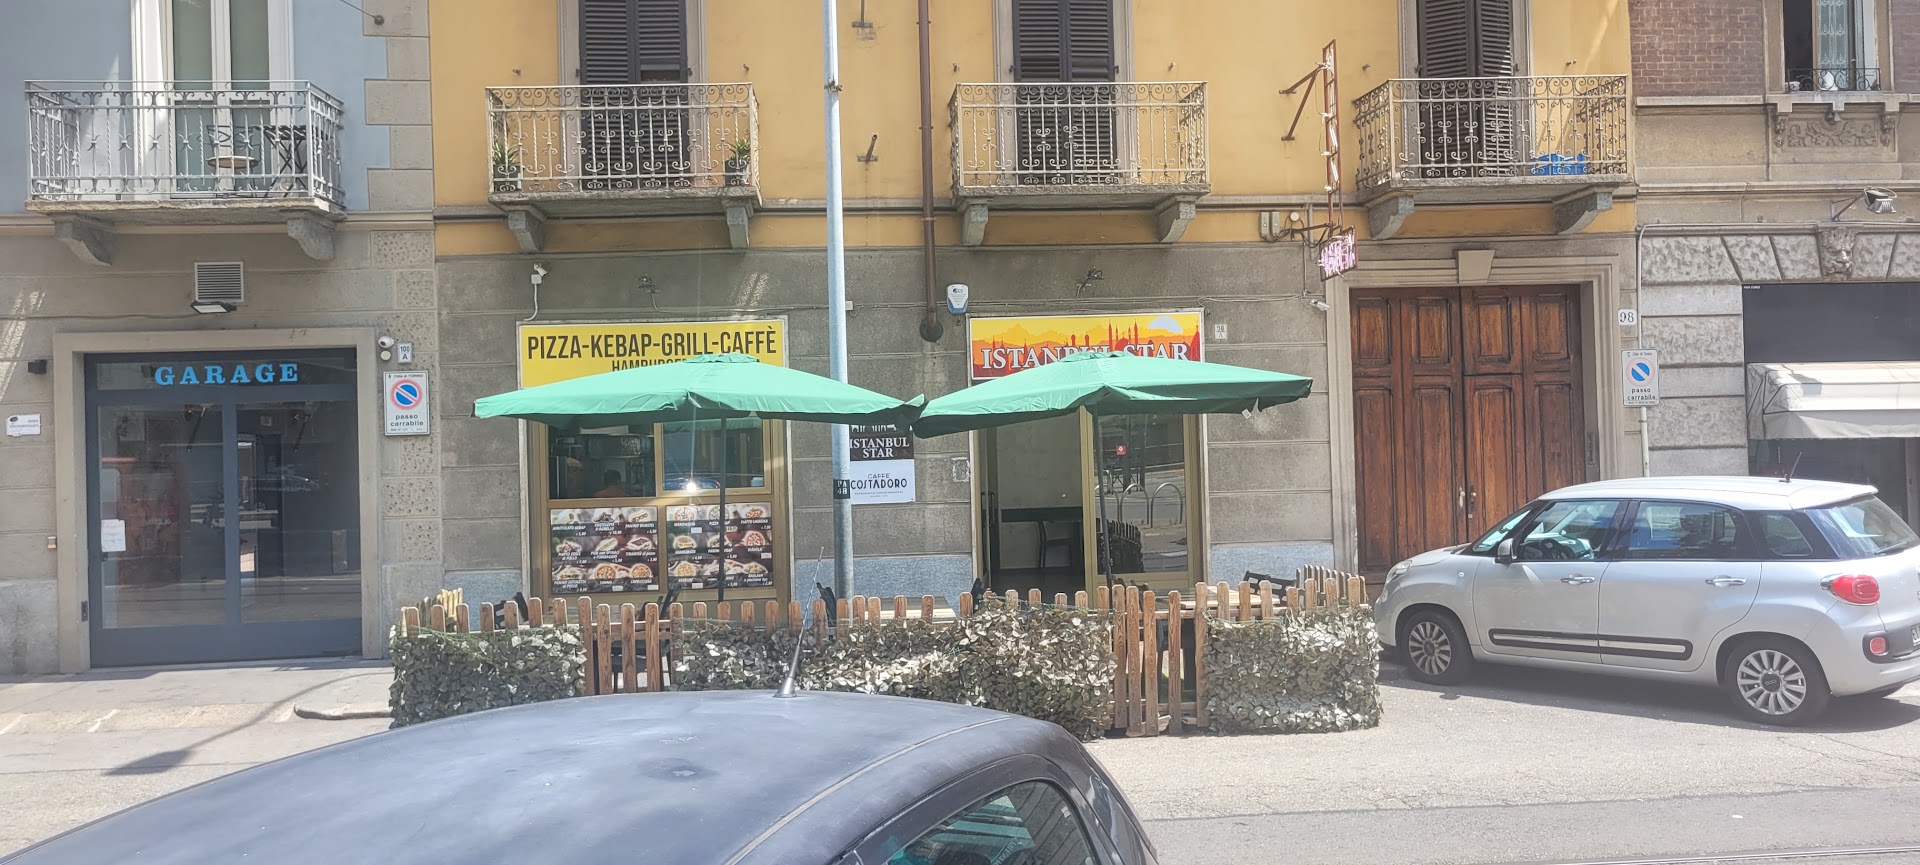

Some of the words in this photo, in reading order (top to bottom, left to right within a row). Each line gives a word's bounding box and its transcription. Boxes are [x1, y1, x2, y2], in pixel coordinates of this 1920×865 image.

[1619, 311, 1635, 323] 98
[527, 326, 777, 359] PIZZA-KEBAP-GRILL-CAFFÈ
[399, 345, 411, 353] 100
[981, 345, 1109, 369] ISTAN
[154, 363, 298, 386] GARAGE
[849, 437, 909, 449] ISTANBUL
[862, 447, 894, 458] STAR
[850, 478, 908, 490] COSTADORO
